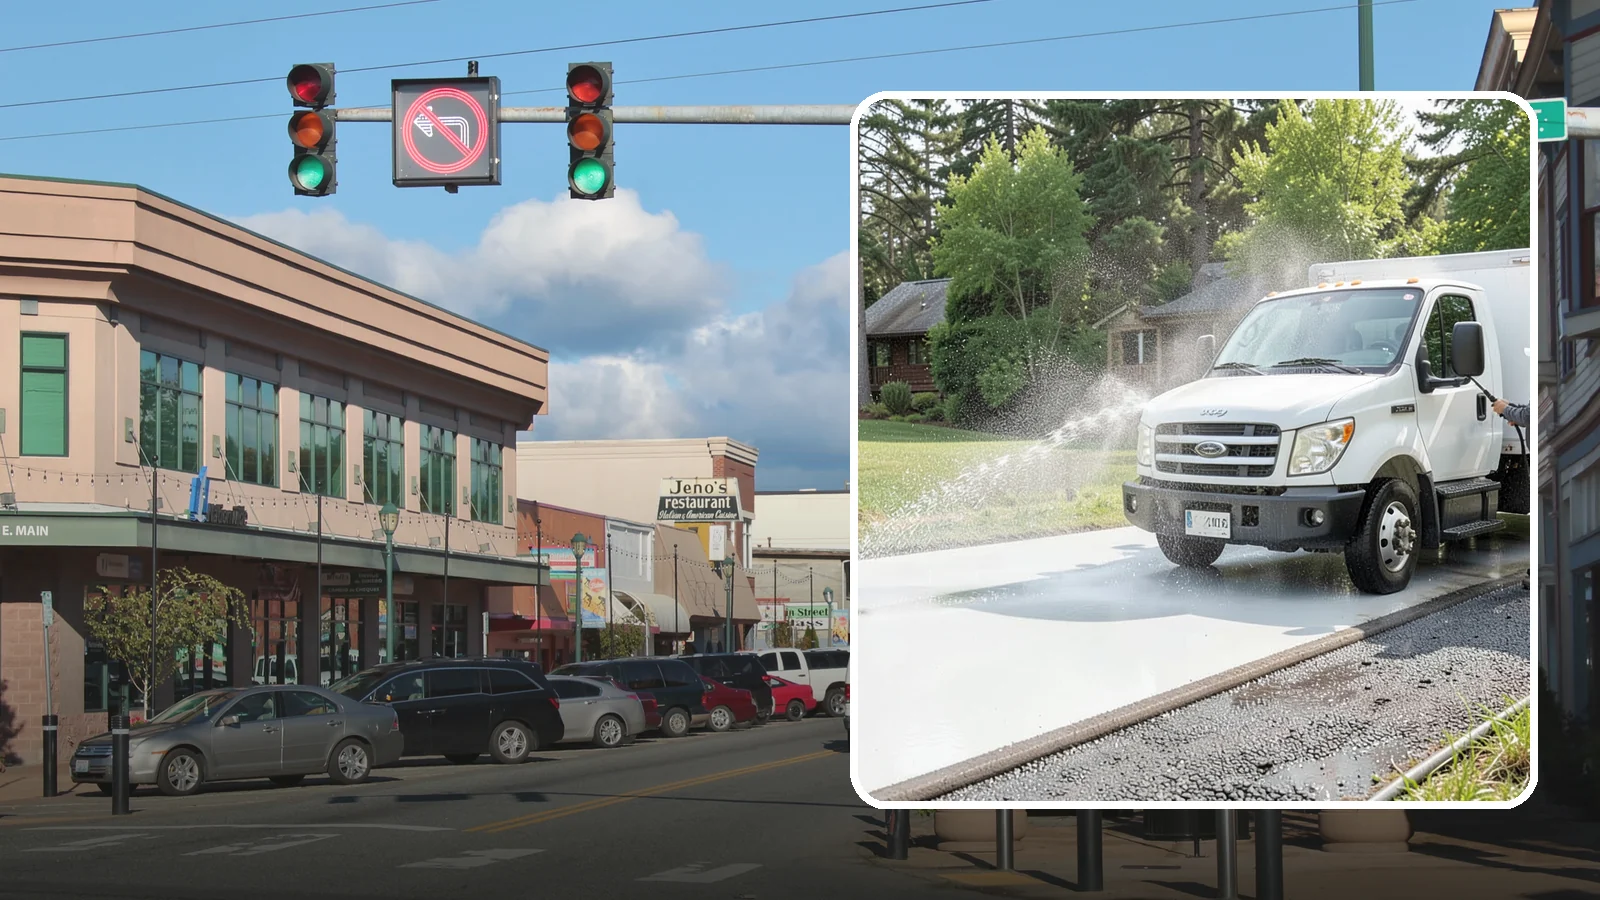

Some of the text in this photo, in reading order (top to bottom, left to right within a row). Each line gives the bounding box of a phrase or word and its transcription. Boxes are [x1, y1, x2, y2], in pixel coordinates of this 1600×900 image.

[670, 480, 727, 494] Jeno's
[665, 496, 731, 508] restaurant
[658, 509, 681, 519] Italian
[686, 509, 714, 519] American
[715, 509, 737, 519] Cuisine
[2, 525, 49, 536] E. MAIN
[797, 607, 828, 617] Street
[790, 618, 824, 626] lass
